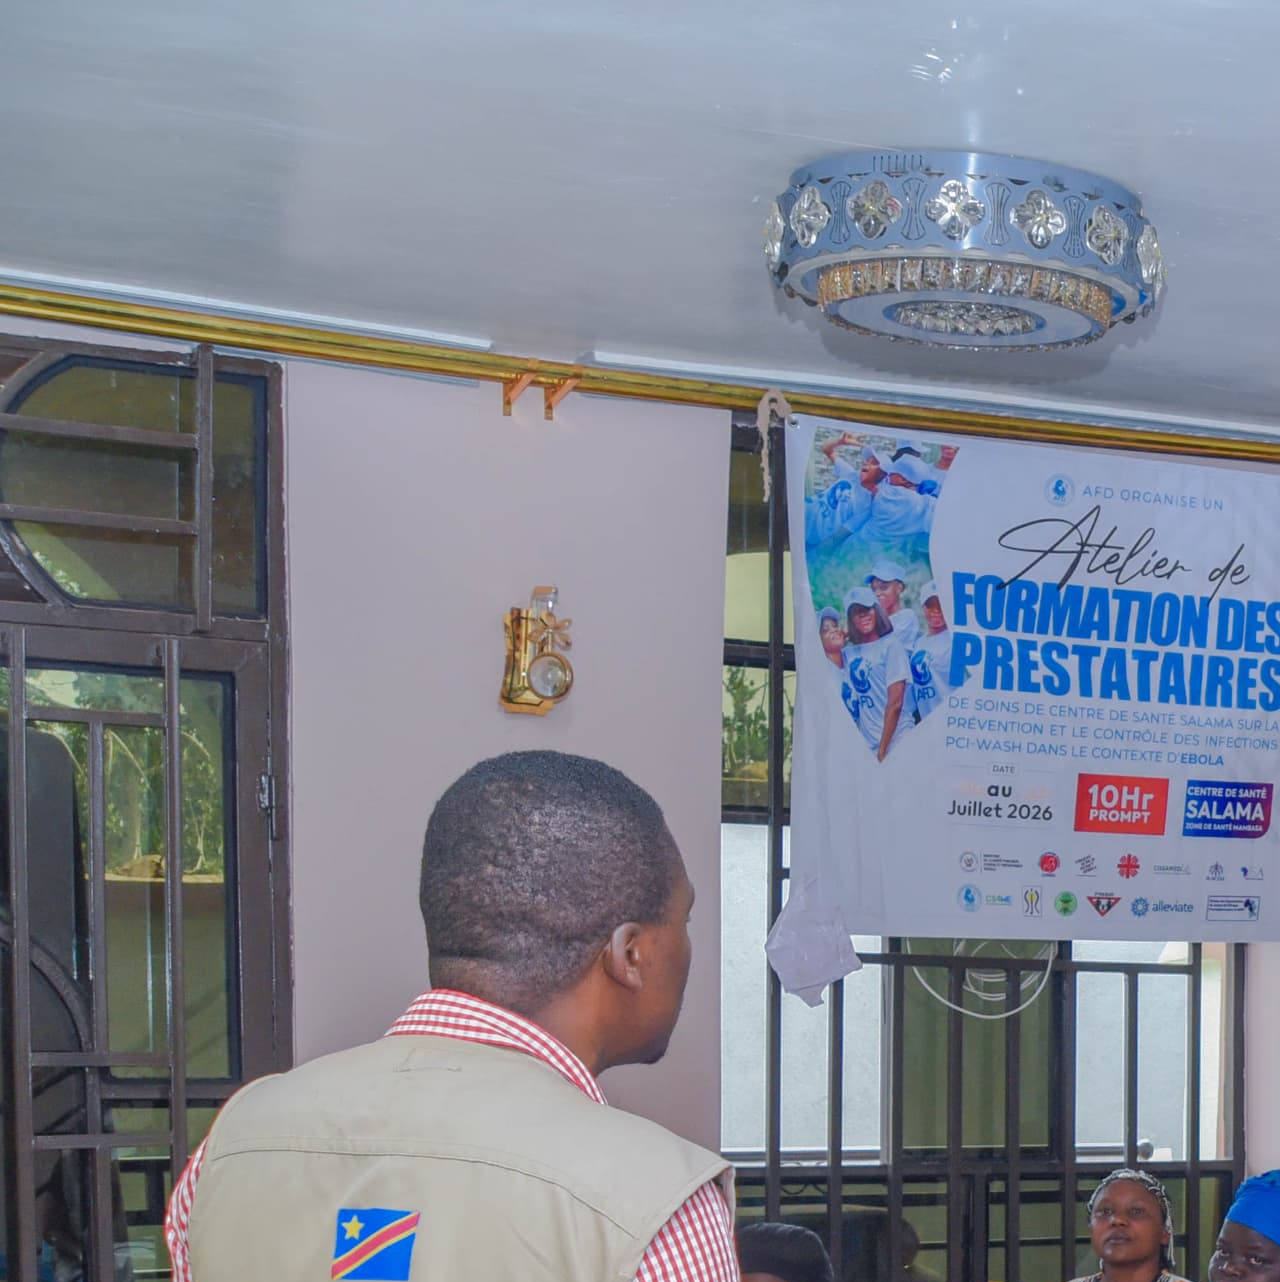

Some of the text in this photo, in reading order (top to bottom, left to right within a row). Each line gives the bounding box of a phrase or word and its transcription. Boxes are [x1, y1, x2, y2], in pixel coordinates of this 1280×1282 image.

[1082, 485, 1224, 511] AFD ORGANISE UN
[995, 504, 1251, 608] Atelier de
[952, 571, 1211, 650] FORMATION
[948, 697, 1279, 732] DE SOINS DE CENTRE DE SANTÉ SALAMA SUR LA
[946, 715, 1278, 750] PRÉVENTION ET LE CONTRÔLE DES INFECTIONS
[946, 736, 1224, 766] PCI-WASH DANS LE CONTEXTE D'EBOLA
[992, 764, 1016, 774] DATE
[987, 784, 1013, 797] au
[1088, 783, 1154, 810] 10Hr
[1187, 786, 1267, 799] CENTRE DE SANTÉ
[947, 800, 1053, 820] Juillet 2026
[1089, 808, 1151, 824] PROMPT
[1186, 799, 1265, 821] SALAMA
[1152, 900, 1194, 913] alleviate
